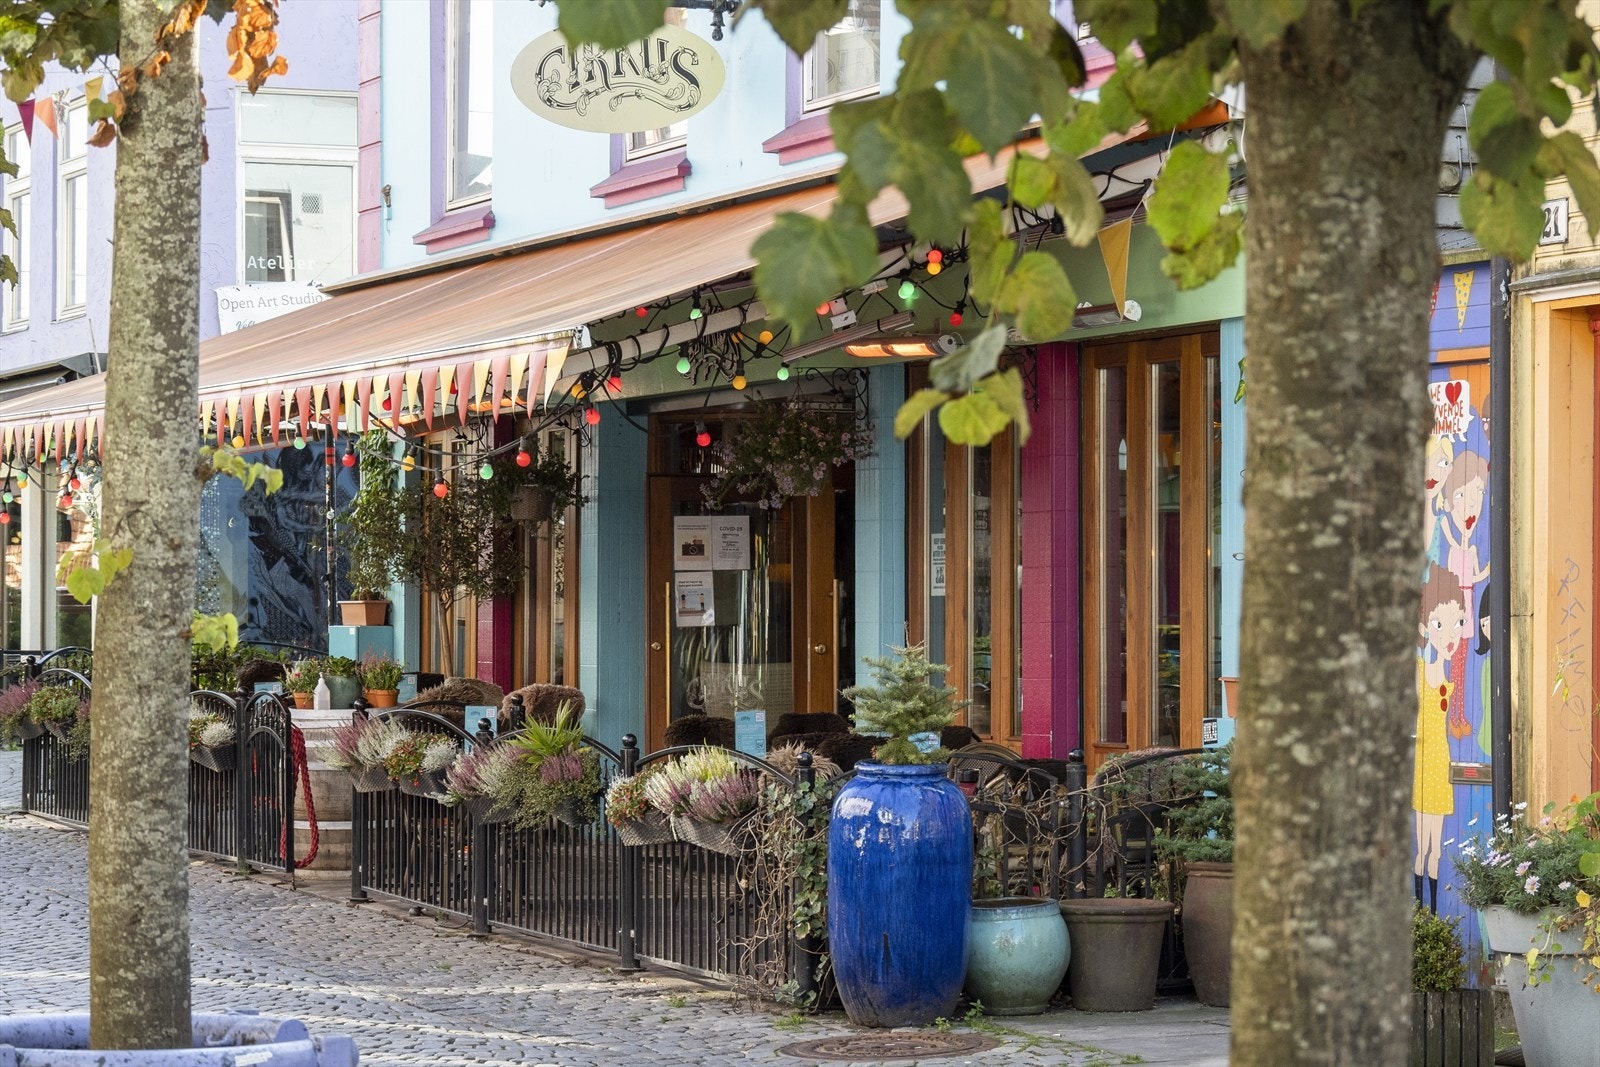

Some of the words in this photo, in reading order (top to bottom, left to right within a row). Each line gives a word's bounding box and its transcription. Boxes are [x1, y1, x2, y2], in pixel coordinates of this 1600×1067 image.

[247, 255, 316, 270] Atelier
[220, 298, 254, 312] Open
[257, 294, 278, 308] Art
[281, 293, 323, 306] Studio
[1431, 384, 1441, 401] WE
